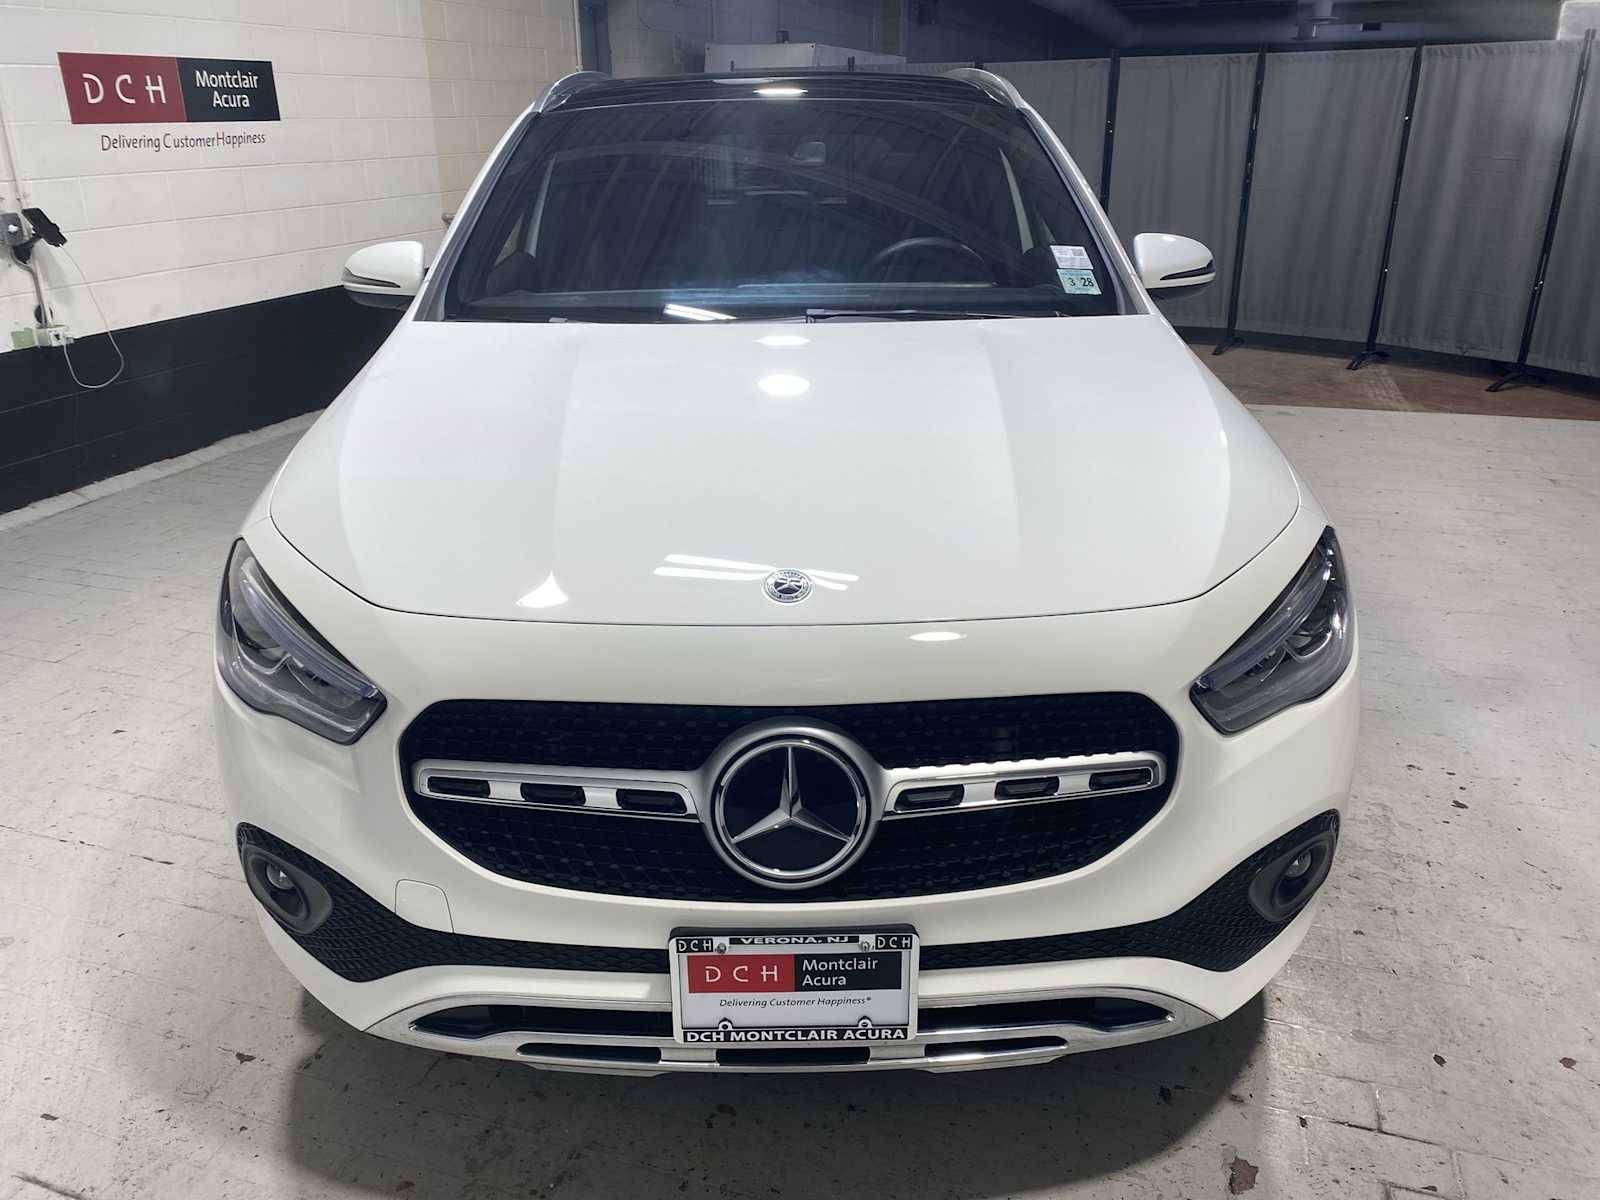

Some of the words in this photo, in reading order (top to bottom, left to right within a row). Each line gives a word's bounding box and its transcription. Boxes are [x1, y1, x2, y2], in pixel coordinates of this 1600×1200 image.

[195, 71, 259, 89] Montclair
[82, 73, 166, 104] DCH
[212, 91, 250, 108] Acura
[101, 135, 161, 152] Delivering
[163, 133, 216, 149] Customer
[216, 132, 266, 149] Happiness
[1068, 277, 1076, 287] 3
[678, 939, 712, 952] DCH
[827, 936, 849, 944] NJ
[877, 936, 912, 949] DCH
[802, 957, 878, 972] Montclair
[705, 965, 778, 983] DCH
[802, 973, 847, 987] Acura
[719, 999, 767, 1008] Delivering
[769, 998, 816, 1007] Customer
[686, 1031, 728, 1043] DCH
[730, 1030, 841, 1042] MONTCLAIR
[843, 1028, 905, 1041] ACURA
